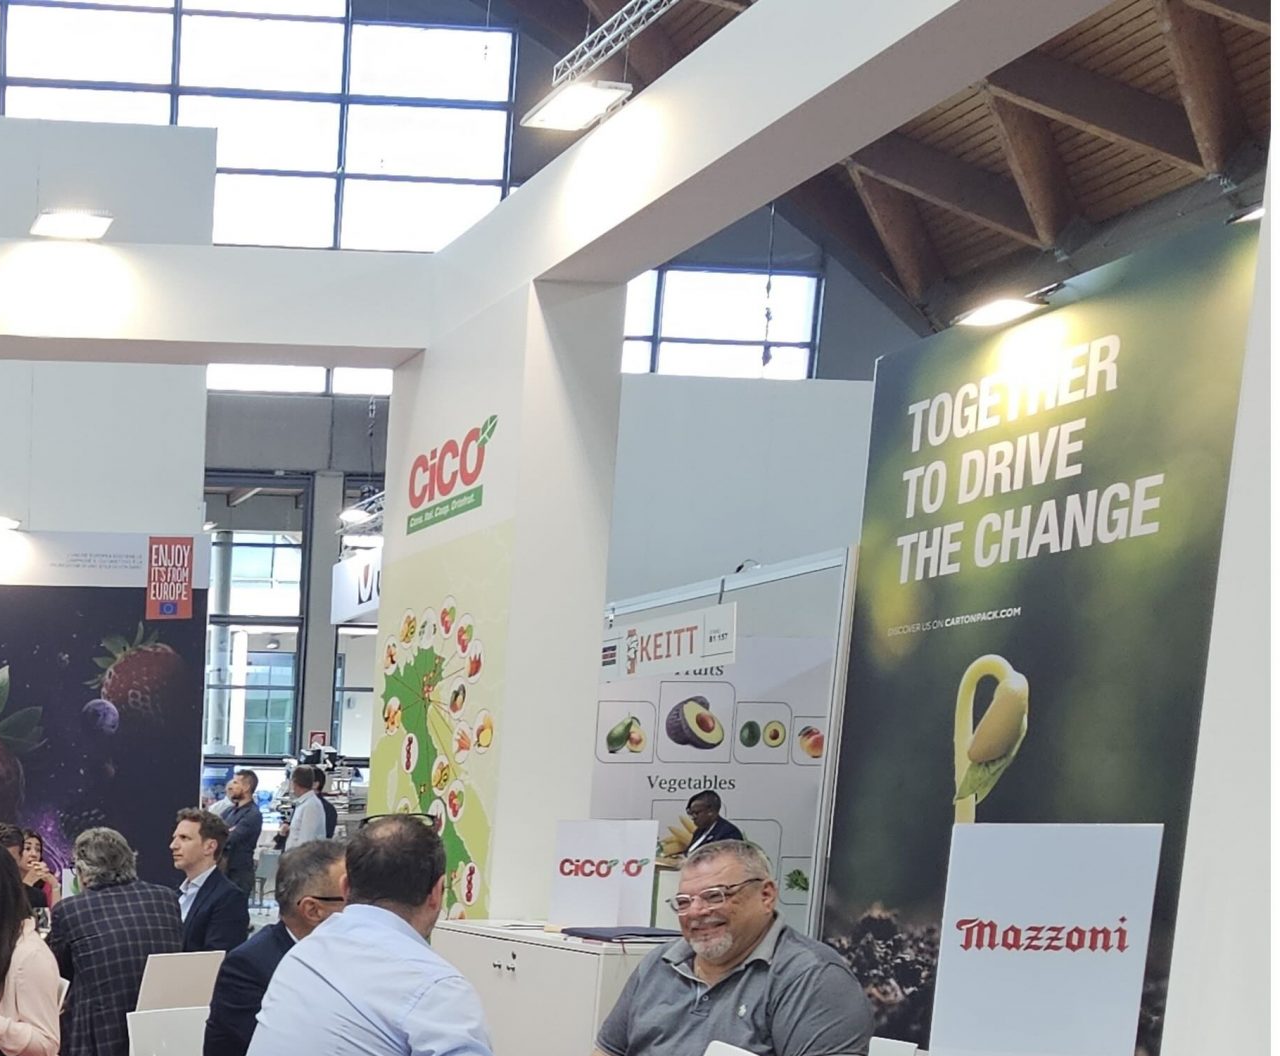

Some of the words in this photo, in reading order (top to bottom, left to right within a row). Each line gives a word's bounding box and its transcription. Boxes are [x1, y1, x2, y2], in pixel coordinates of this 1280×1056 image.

[902, 460, 947, 519] TO
[957, 417, 1087, 505] DRIVE
[896, 520, 965, 585] THE
[973, 472, 1166, 570] CHANGE
[151, 543, 191, 568] ENJOY
[150, 581, 189, 602] EUROPE
[887, 623, 921, 637] DISCOVER
[921, 621, 932, 632] US
[932, 618, 945, 630] ON
[944, 606, 1022, 628] CARTONPACK.COM
[640, 625, 699, 663] KEITT
[647, 775, 736, 792] Vegetables
[955, 915, 1130, 953] Mazzoni
